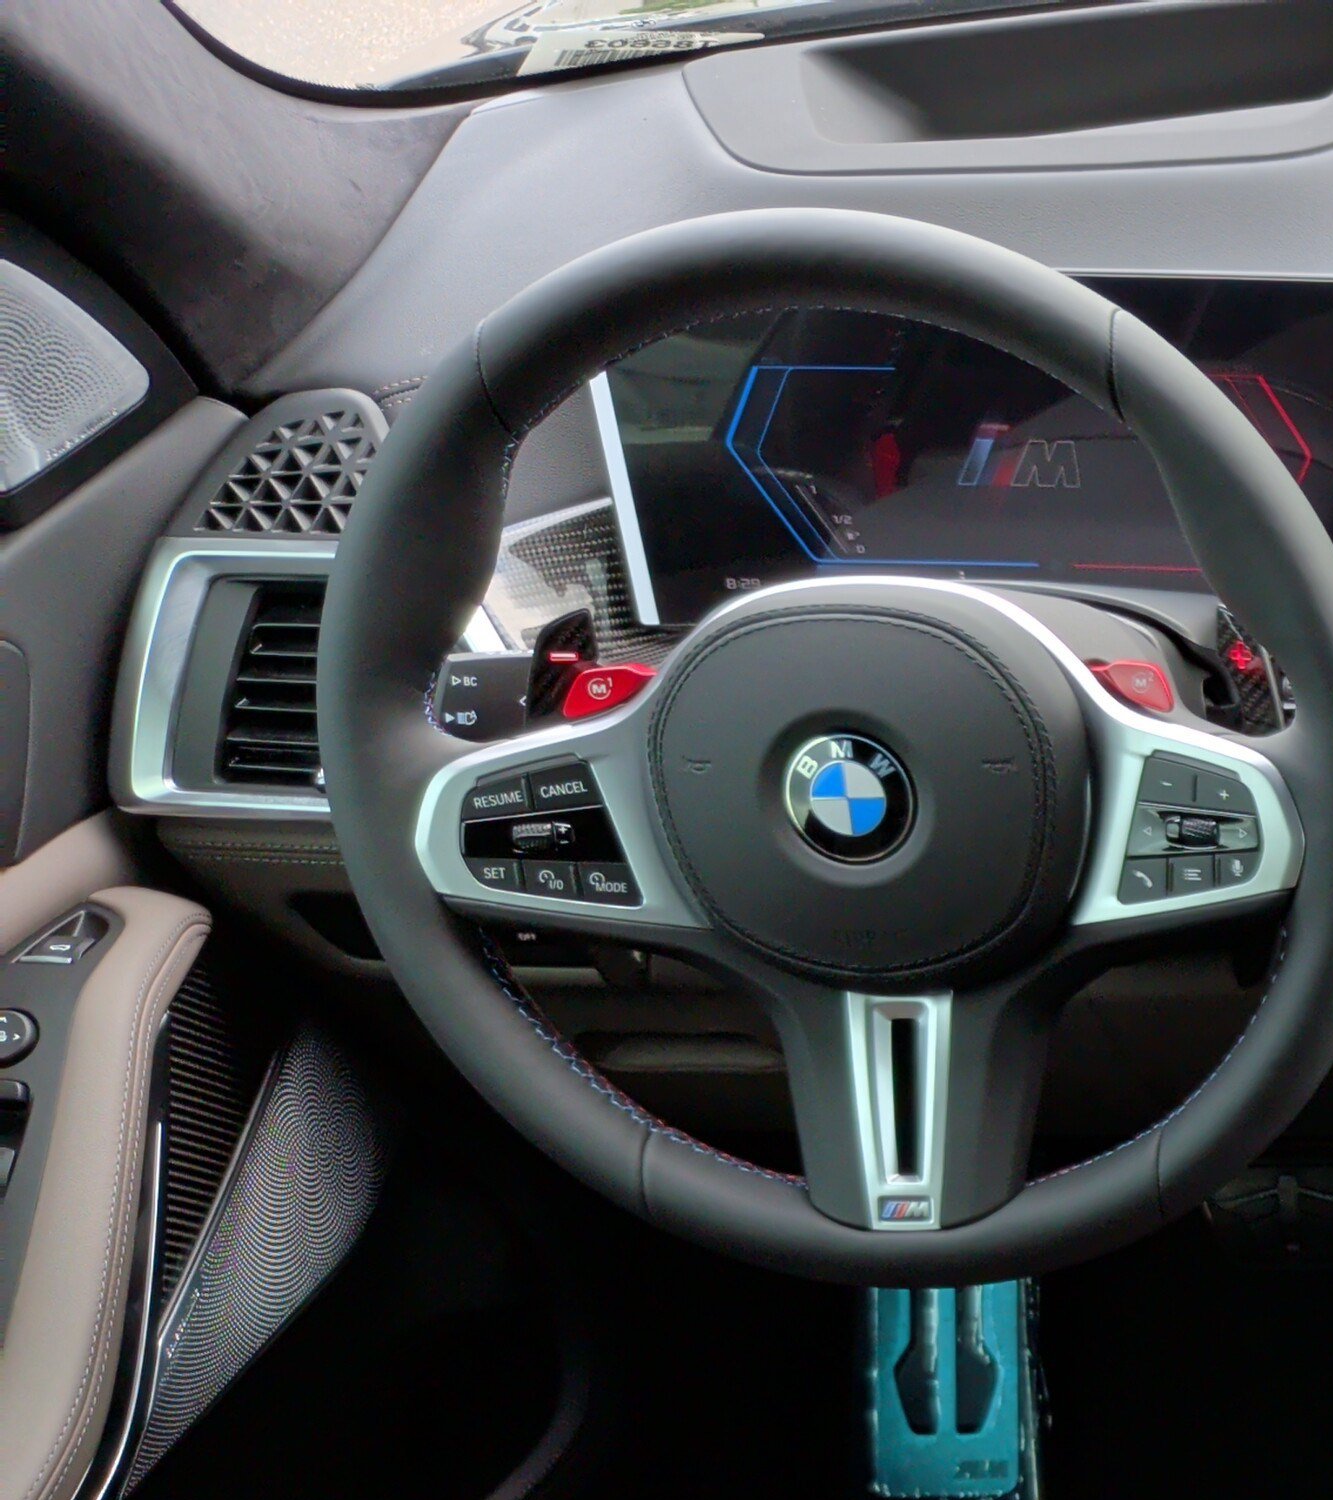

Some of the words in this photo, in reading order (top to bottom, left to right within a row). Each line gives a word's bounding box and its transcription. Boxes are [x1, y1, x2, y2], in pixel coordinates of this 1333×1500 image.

[463, 676, 478, 687] BC
[540, 780, 588, 799] CANCEL
[473, 790, 524, 810] RESUME
[484, 867, 506, 880] SET
[595, 882, 628, 894] MODE
